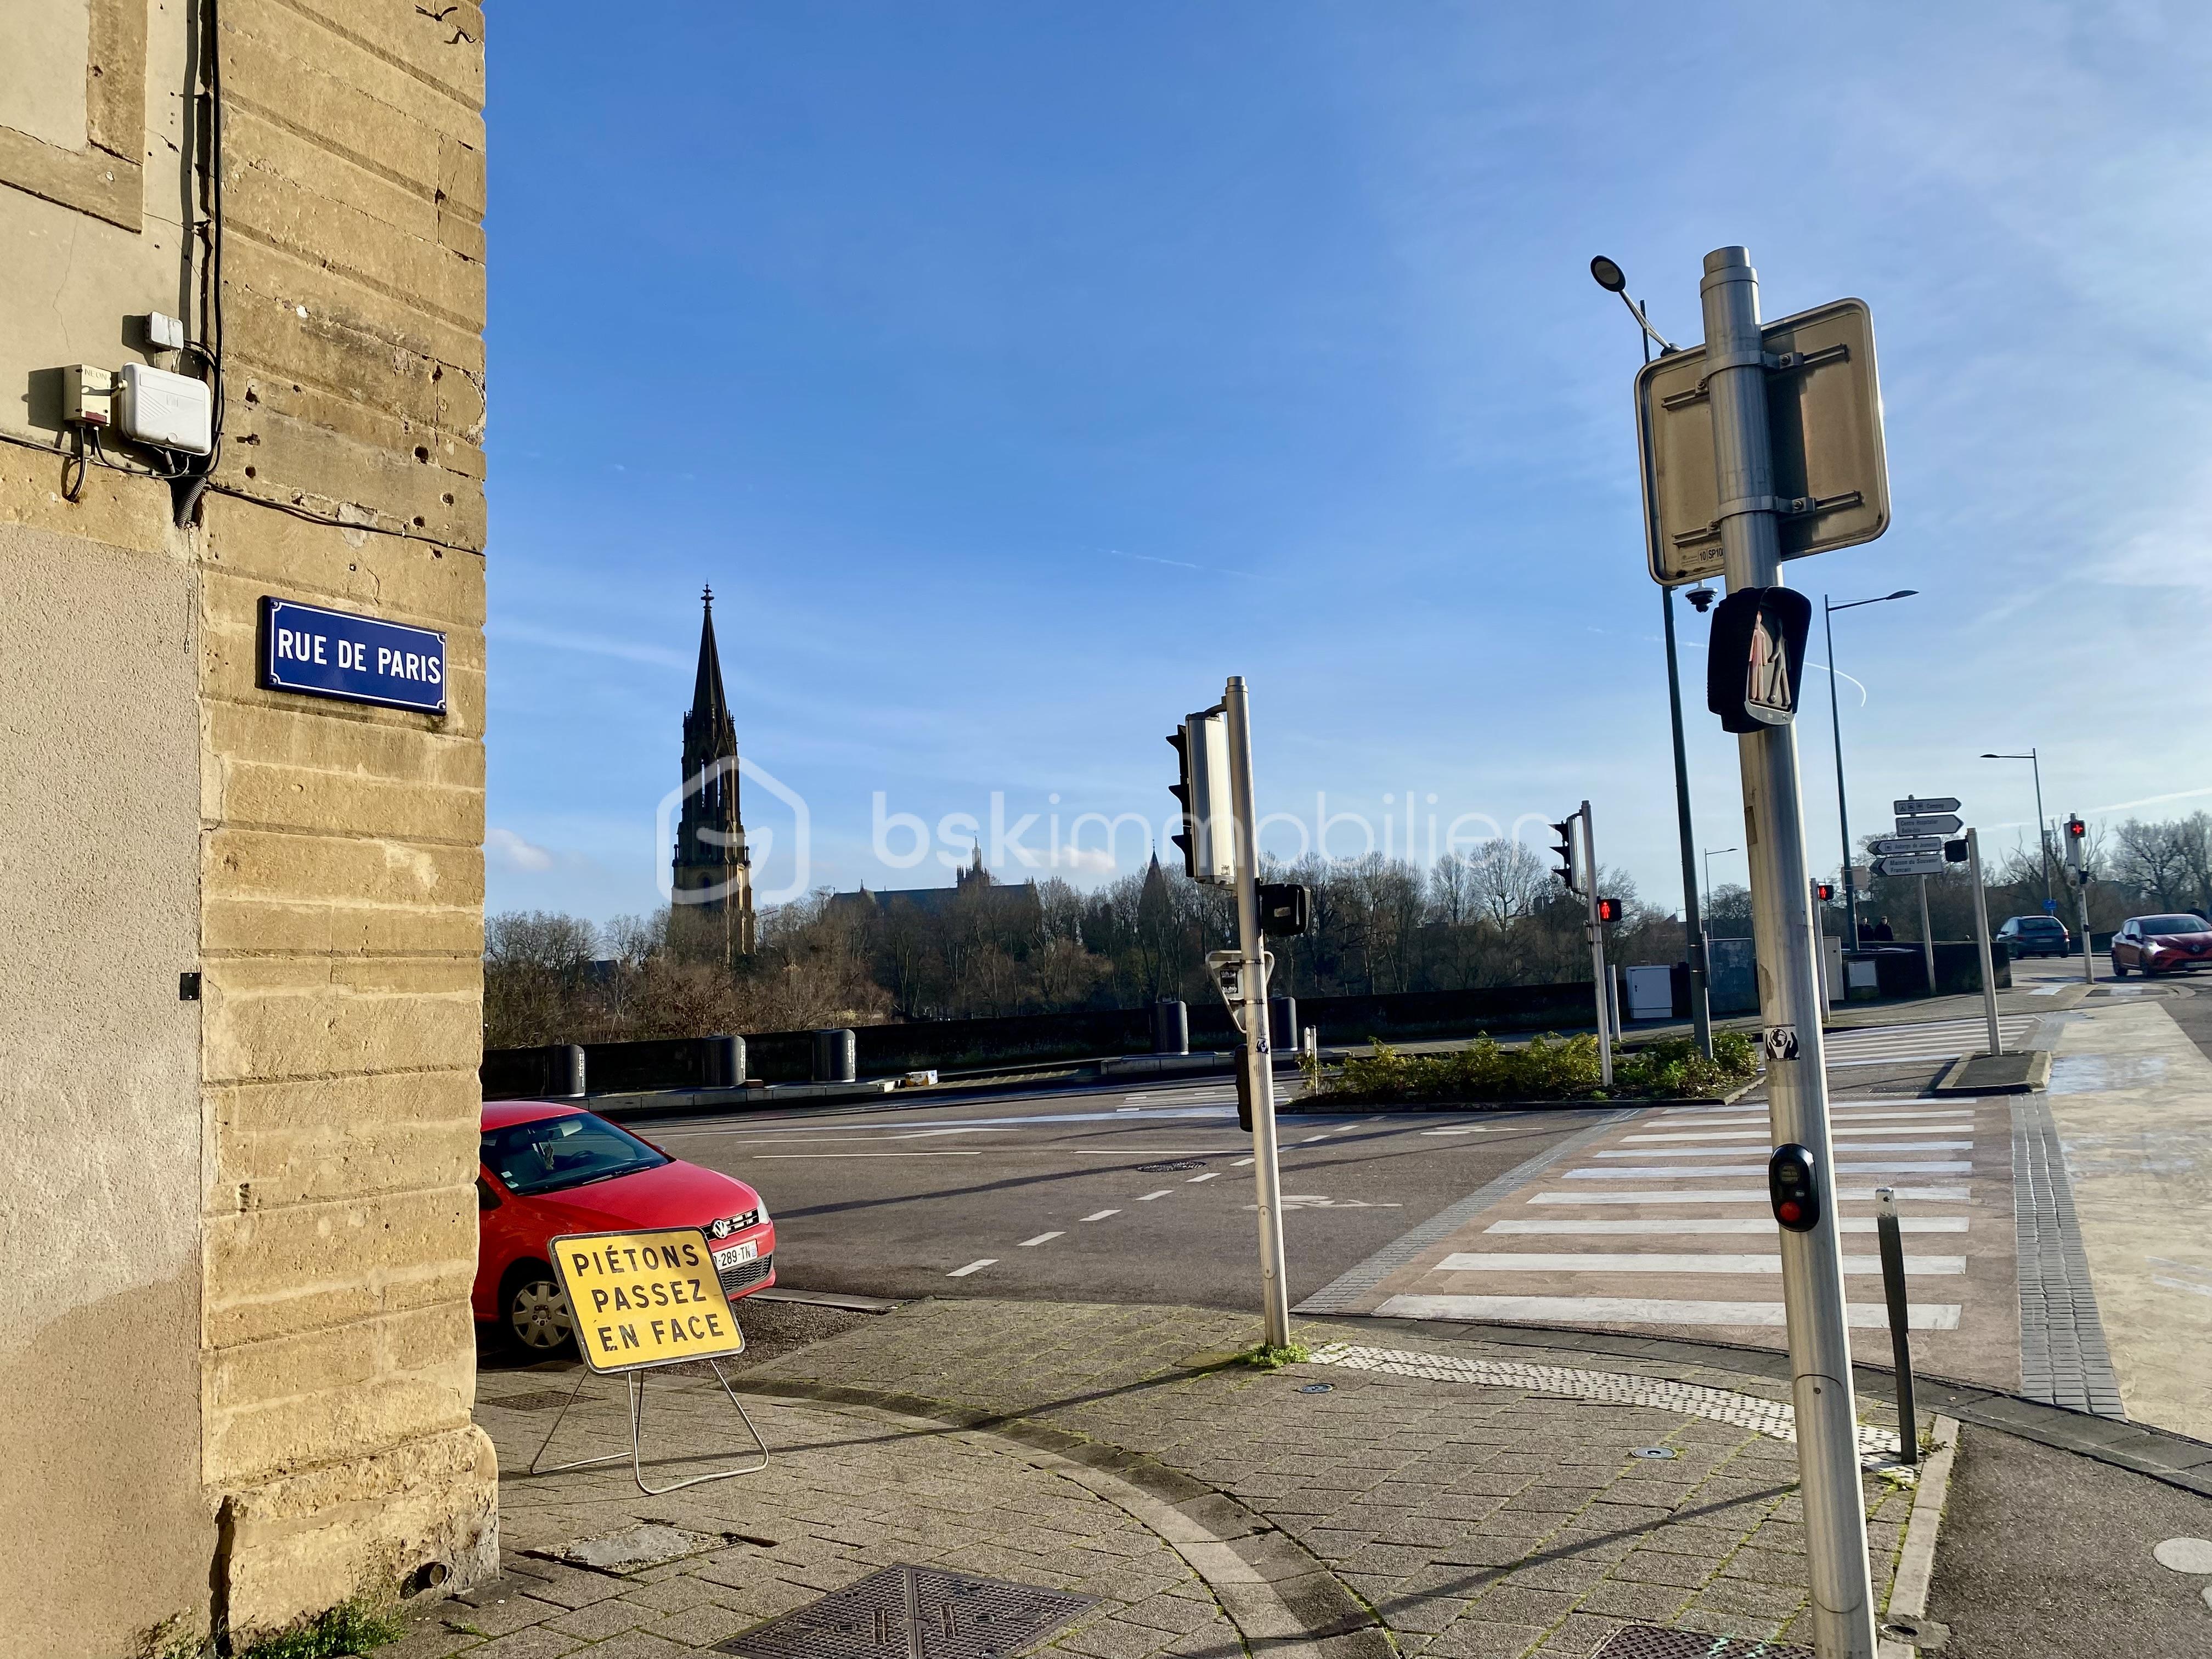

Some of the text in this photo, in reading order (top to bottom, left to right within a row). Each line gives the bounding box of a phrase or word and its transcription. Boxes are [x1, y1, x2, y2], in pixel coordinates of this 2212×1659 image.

[84, 368, 107, 380] NEON
[278, 628, 441, 684] RUE DE PARIS
[572, 1244, 699, 1277] PIÉTONS
[591, 1279, 707, 1313] PASSEZ
[597, 1313, 724, 1352] EN FACE
